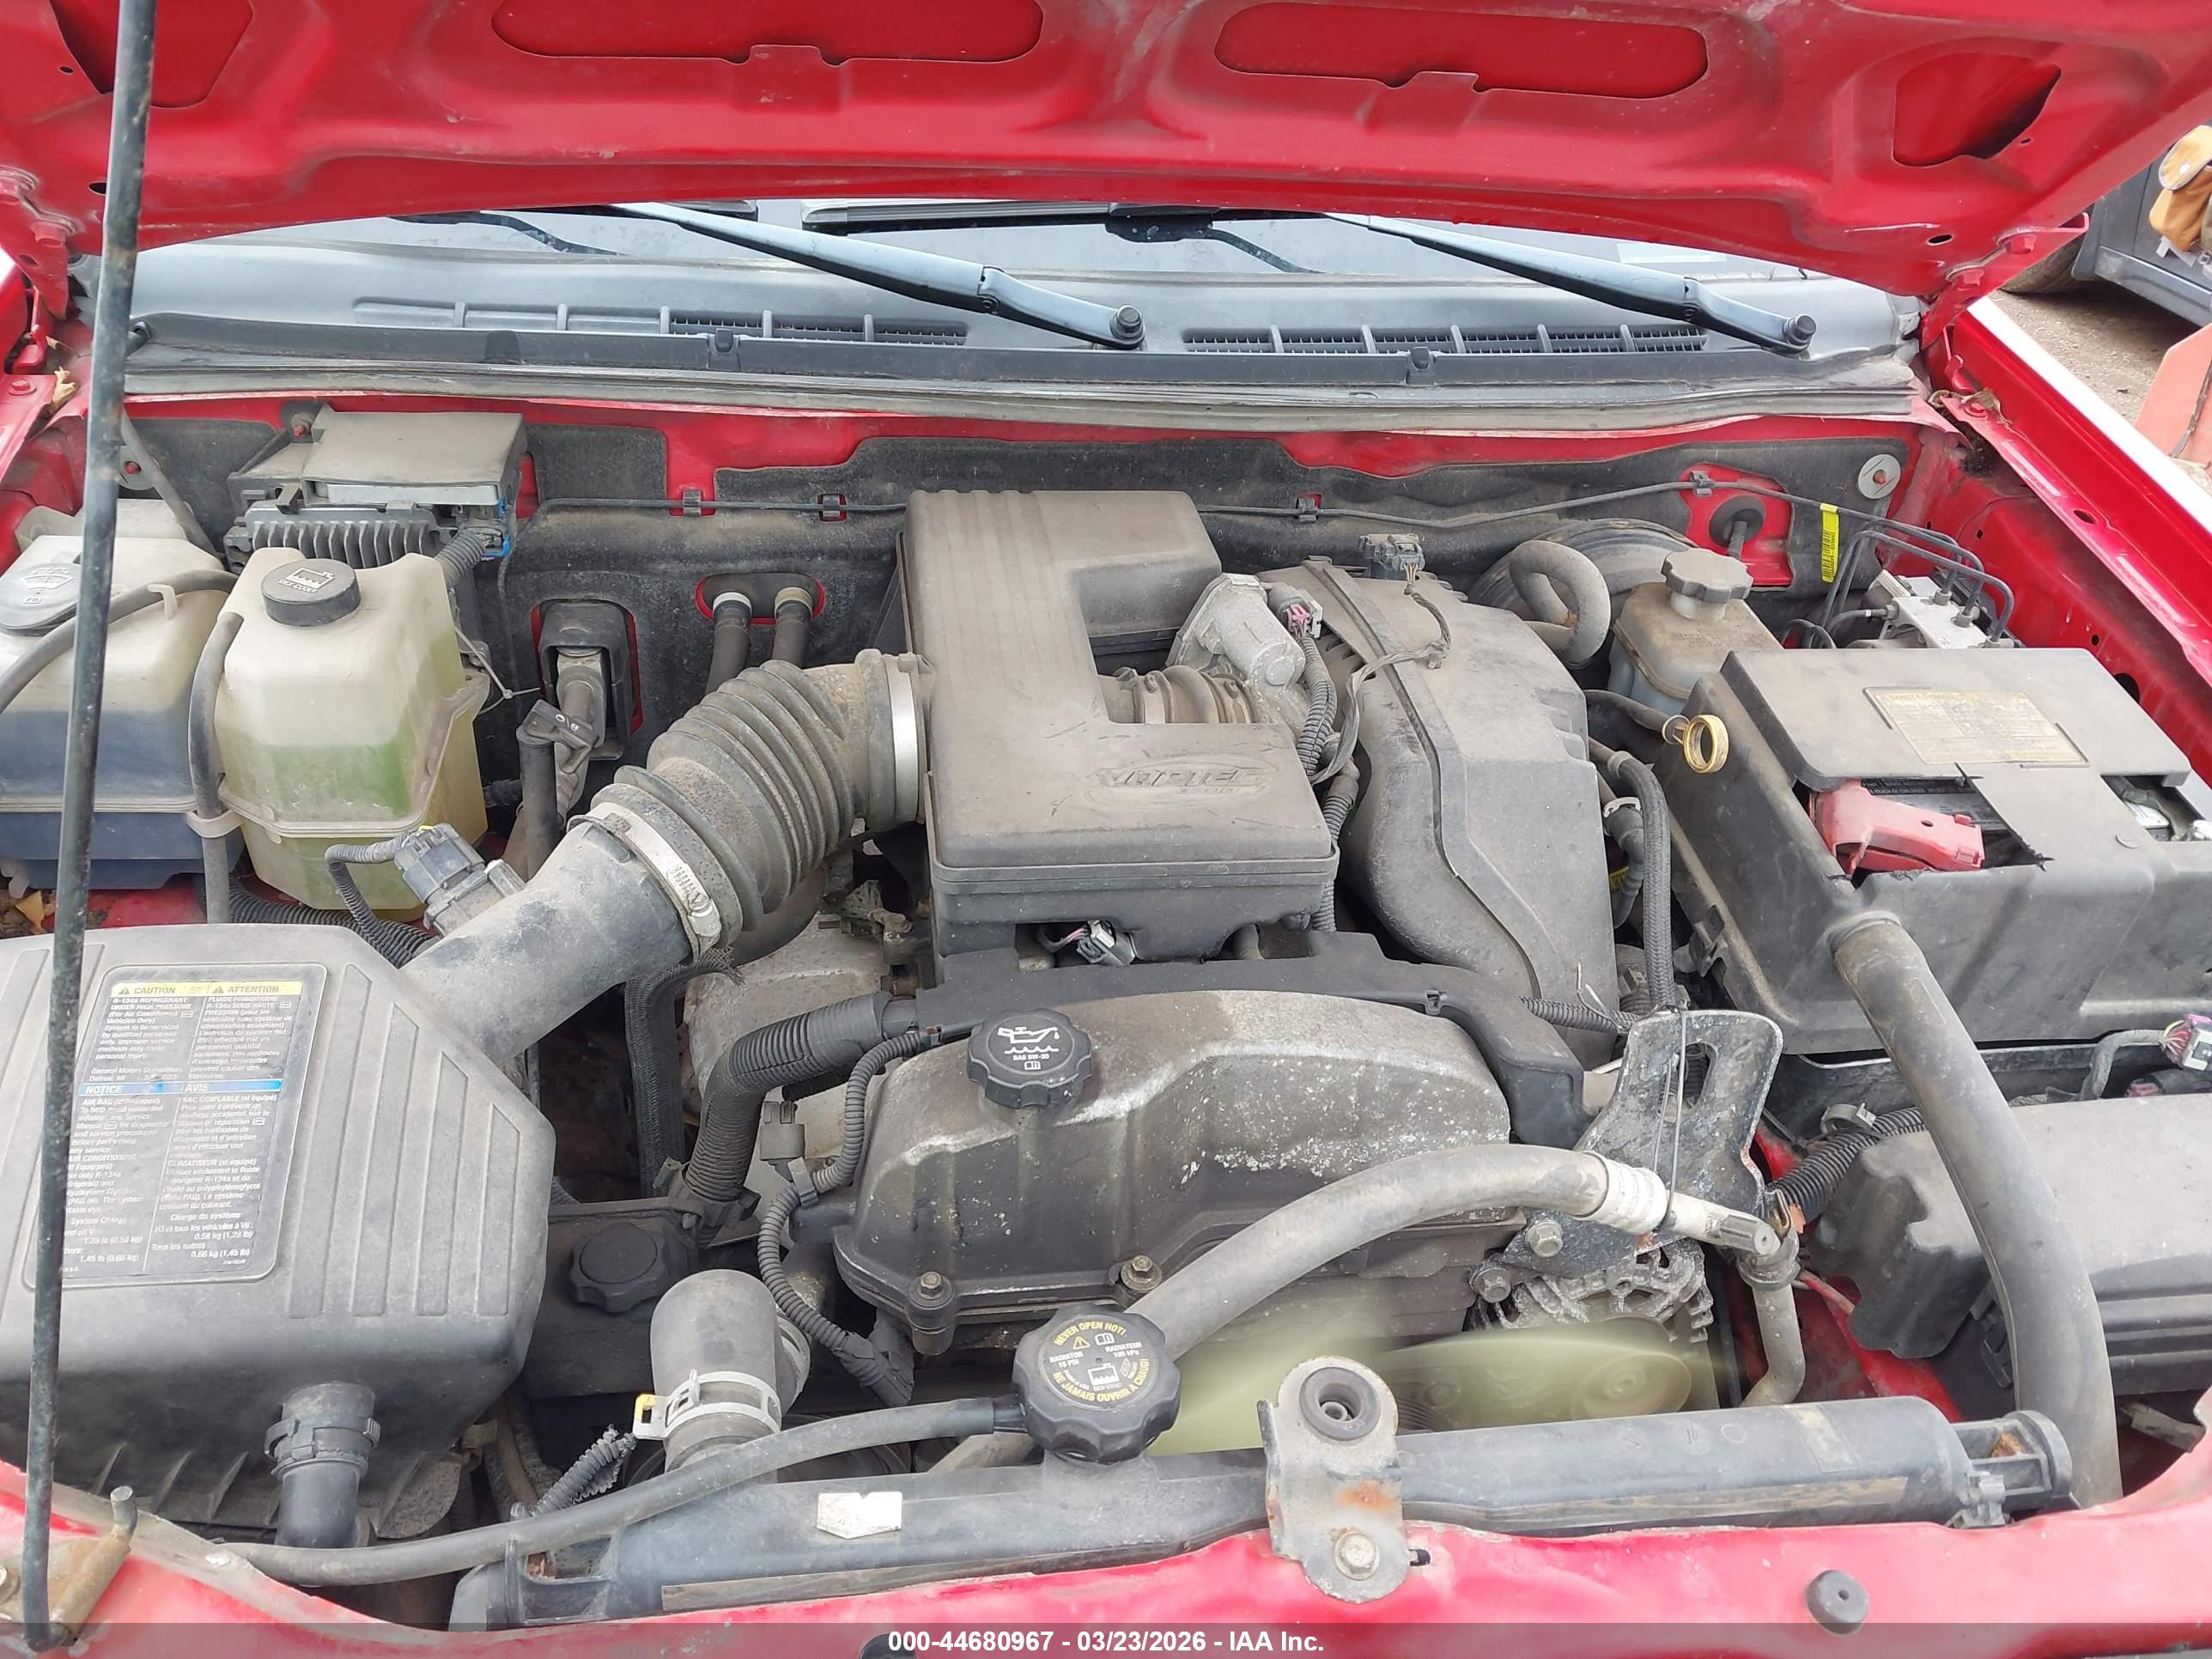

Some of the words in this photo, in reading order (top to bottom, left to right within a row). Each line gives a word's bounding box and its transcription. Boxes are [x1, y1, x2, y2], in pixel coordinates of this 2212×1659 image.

[227, 985, 279, 994] ATTENTION
[85, 1085, 125, 1094] NOTICE
[185, 1083, 208, 1092] AVIS
[1054, 1326, 1079, 1346] NEVER
[1079, 1322, 1103, 1331] OPEN
[1105, 1323, 1127, 1337] HOT!
[1105, 1342, 1142, 1352] RADIATEUR
[1049, 1351, 1084, 1363] RADIATOR
[1053, 1372, 1066, 1384] NE
[1061, 1382, 1096, 1401] JAMAIS
[1097, 1388, 1131, 1401] OUVRIR
